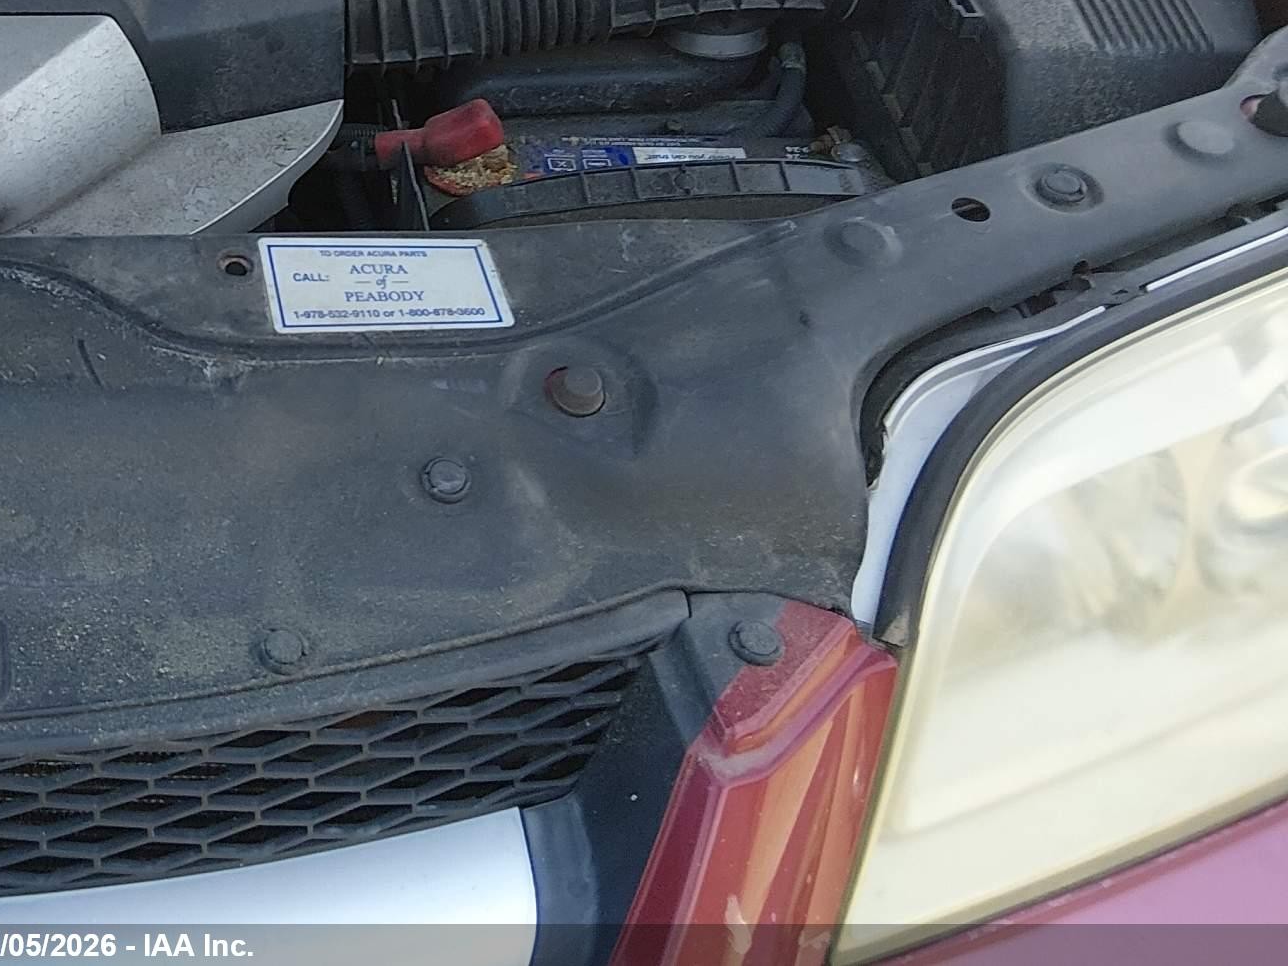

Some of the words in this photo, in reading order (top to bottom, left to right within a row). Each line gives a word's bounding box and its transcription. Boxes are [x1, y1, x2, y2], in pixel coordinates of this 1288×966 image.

[349, 264, 409, 275] ACURA
[292, 272, 330, 282] CALL:
[375, 275, 388, 290] of
[344, 290, 425, 302] PEABODY
[383, 310, 395, 318] or
